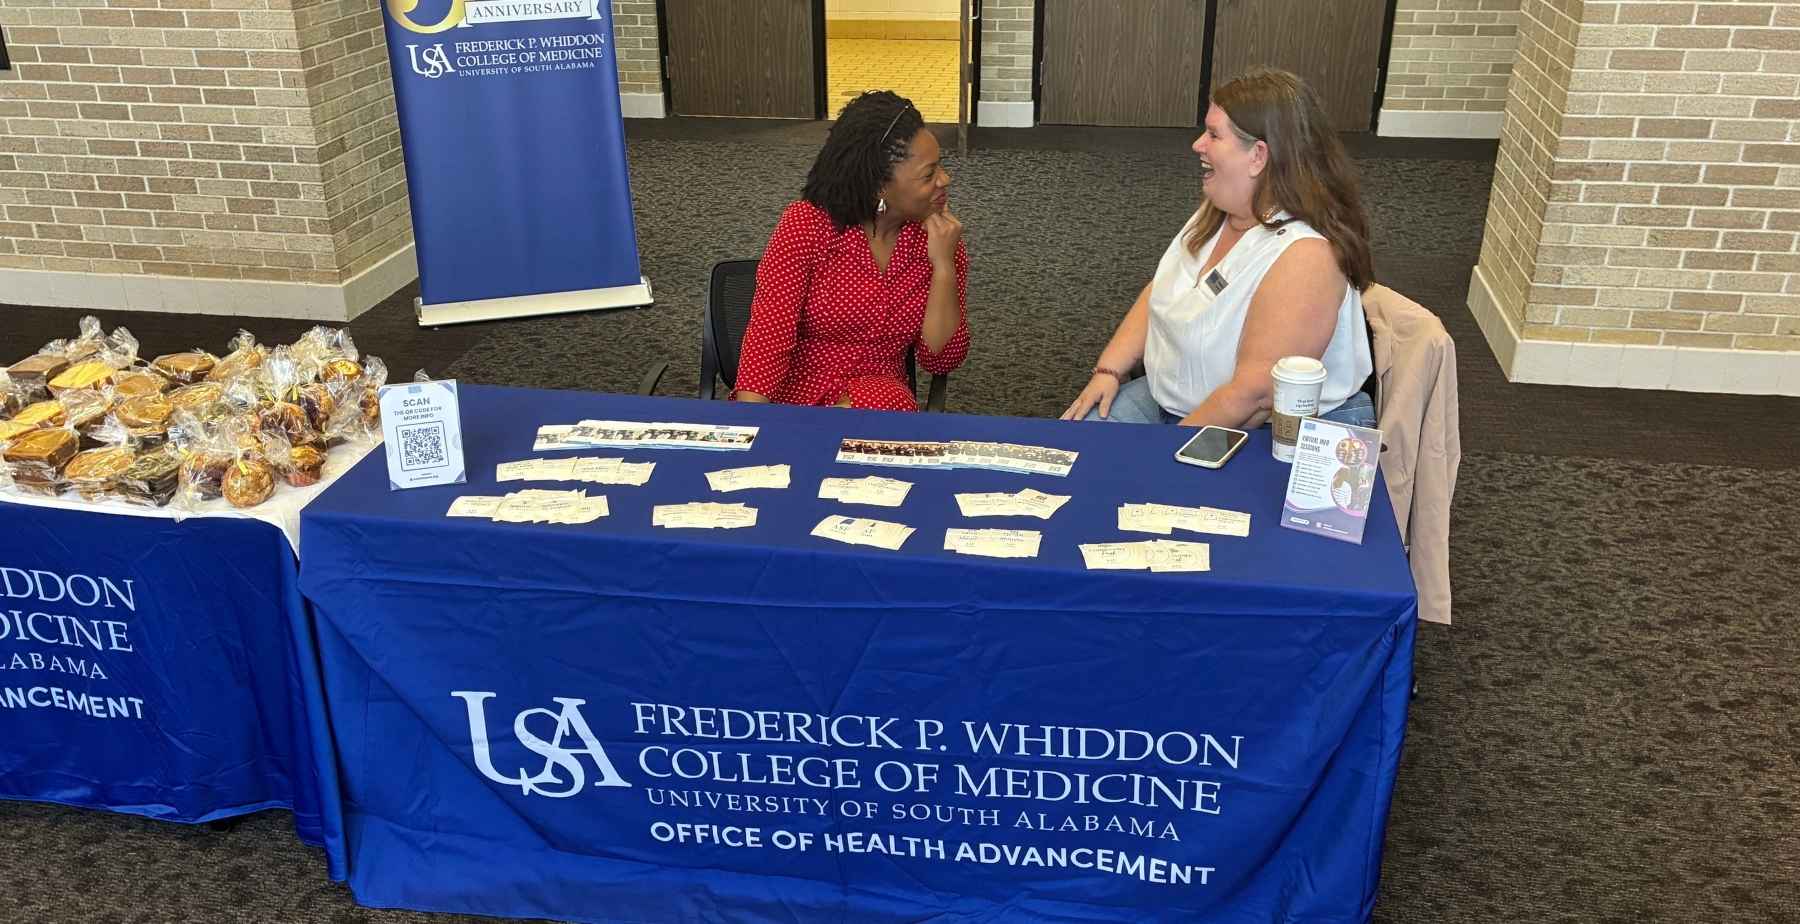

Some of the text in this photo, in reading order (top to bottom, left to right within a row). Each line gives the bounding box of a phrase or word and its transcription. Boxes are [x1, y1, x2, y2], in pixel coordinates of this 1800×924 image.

[473, 1, 583, 18] ANNIVERSARY
[405, 43, 456, 78] USA
[455, 33, 605, 53] FREDERICK P. WHIDDON
[457, 47, 603, 67] COLLEGE OF MEDICINE
[459, 61, 595, 76] UNIVERSITY OF SOUTH ALABAMA
[403, 397, 430, 407] SCAN
[0, 567, 135, 612] DDON
[451, 691, 632, 798] USA
[630, 702, 1244, 769] FREDERICK P. WHIDDON
[638, 745, 1223, 815] COLLEGE OF MEDICINE
[646, 788, 1182, 842] UNIVERSITY OF SOUTH ALABAMA
[650, 821, 1216, 886] OFFICE OF HEALTH ADVANCEMENT
